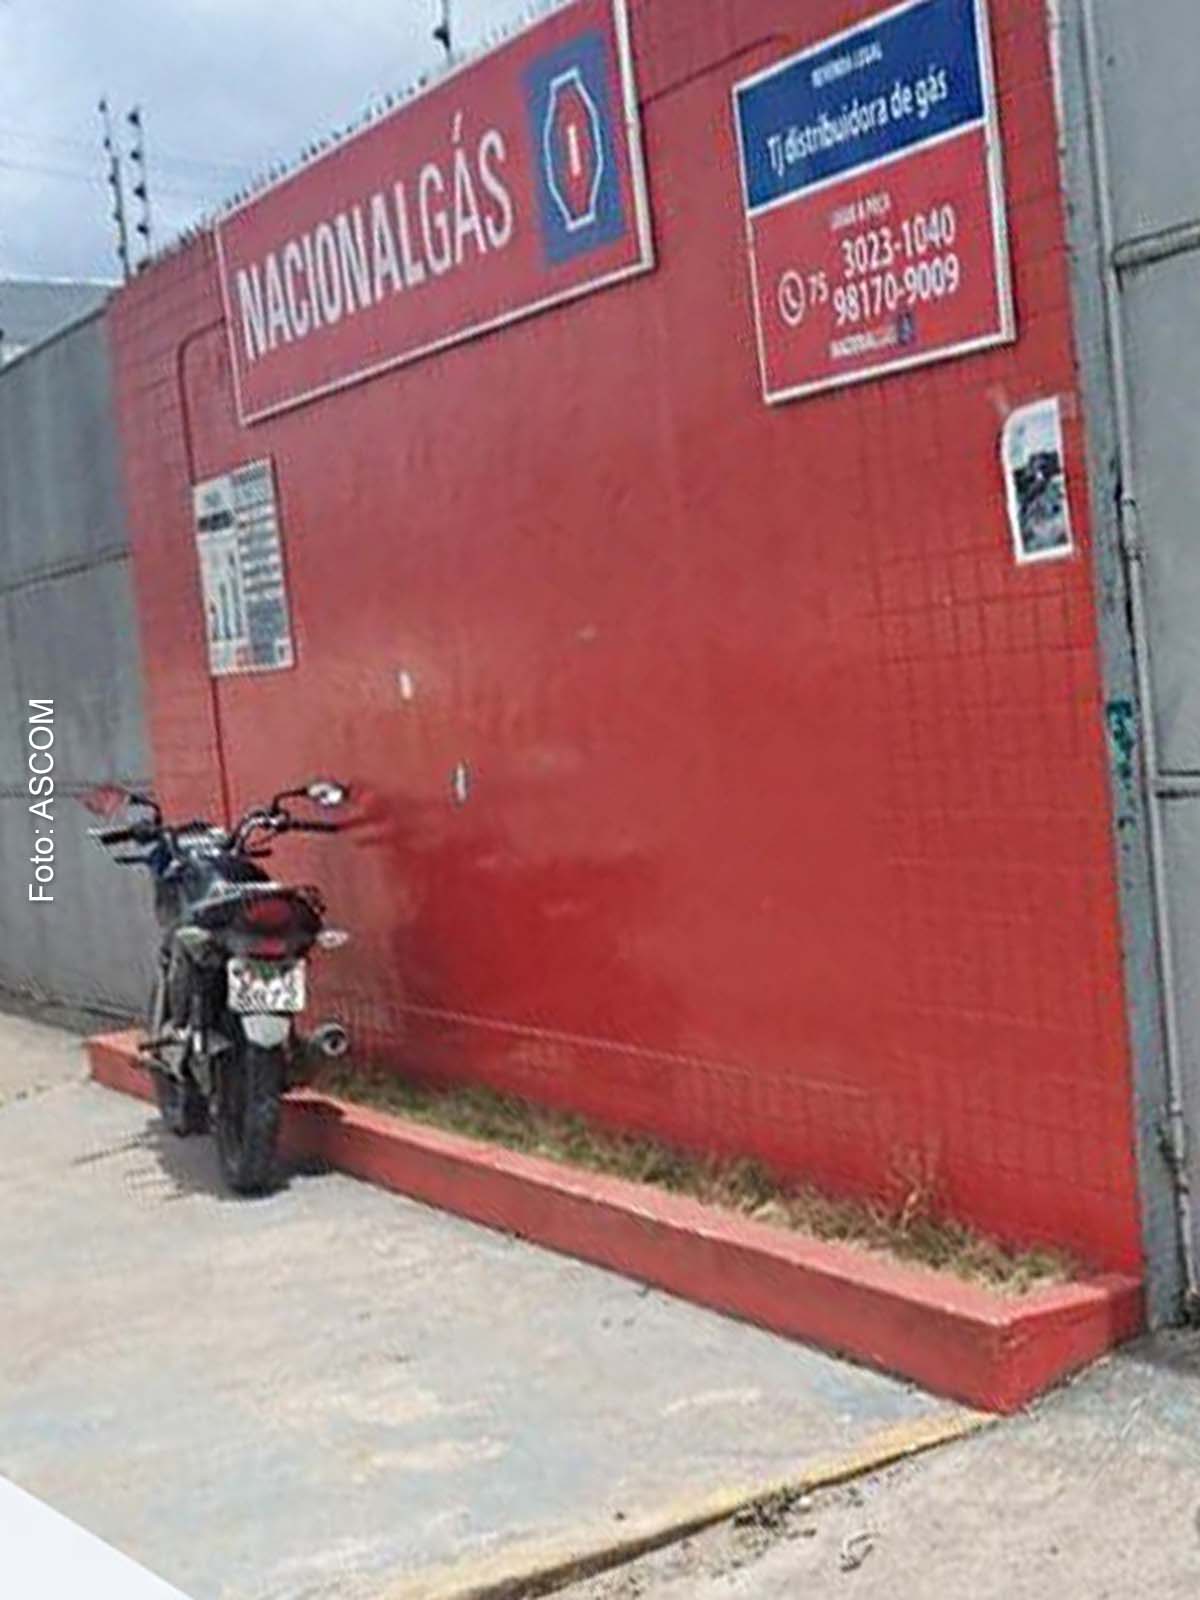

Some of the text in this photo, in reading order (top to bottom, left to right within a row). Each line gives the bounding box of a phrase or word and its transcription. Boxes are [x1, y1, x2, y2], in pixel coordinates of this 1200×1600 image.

[784, 97, 886, 163] distribuidora
[889, 80, 913, 119] de
[914, 65, 948, 118] gás
[237, 113, 513, 360] NACIONALGÁS
[841, 204, 956, 278] 3023-1040
[808, 271, 829, 305] 75
[833, 253, 960, 326] 98170-9009
